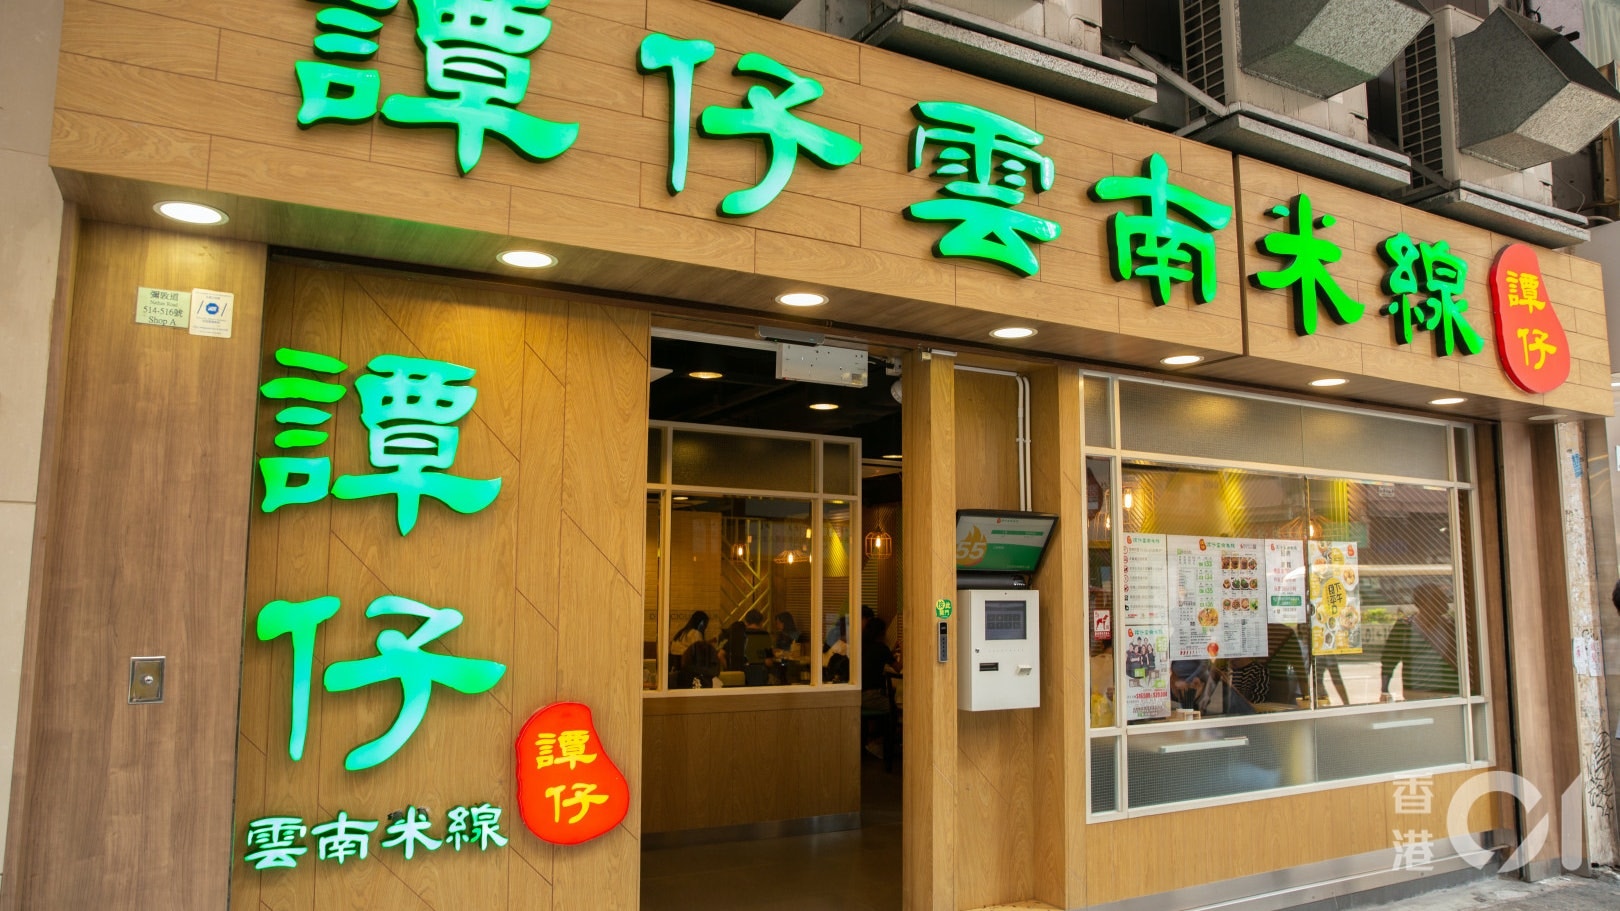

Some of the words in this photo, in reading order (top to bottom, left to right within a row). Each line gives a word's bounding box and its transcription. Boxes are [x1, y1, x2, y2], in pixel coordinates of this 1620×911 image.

[143, 306, 184, 318] 514-516號
[149, 316, 168, 326] Shop
[170, 317, 177, 326] A
[1506, 270, 1558, 371] 譚仔
[257, 347, 507, 772] 譚仔
[535, 730, 609, 824] 譚仔
[244, 804, 510, 871] 雲南米線
